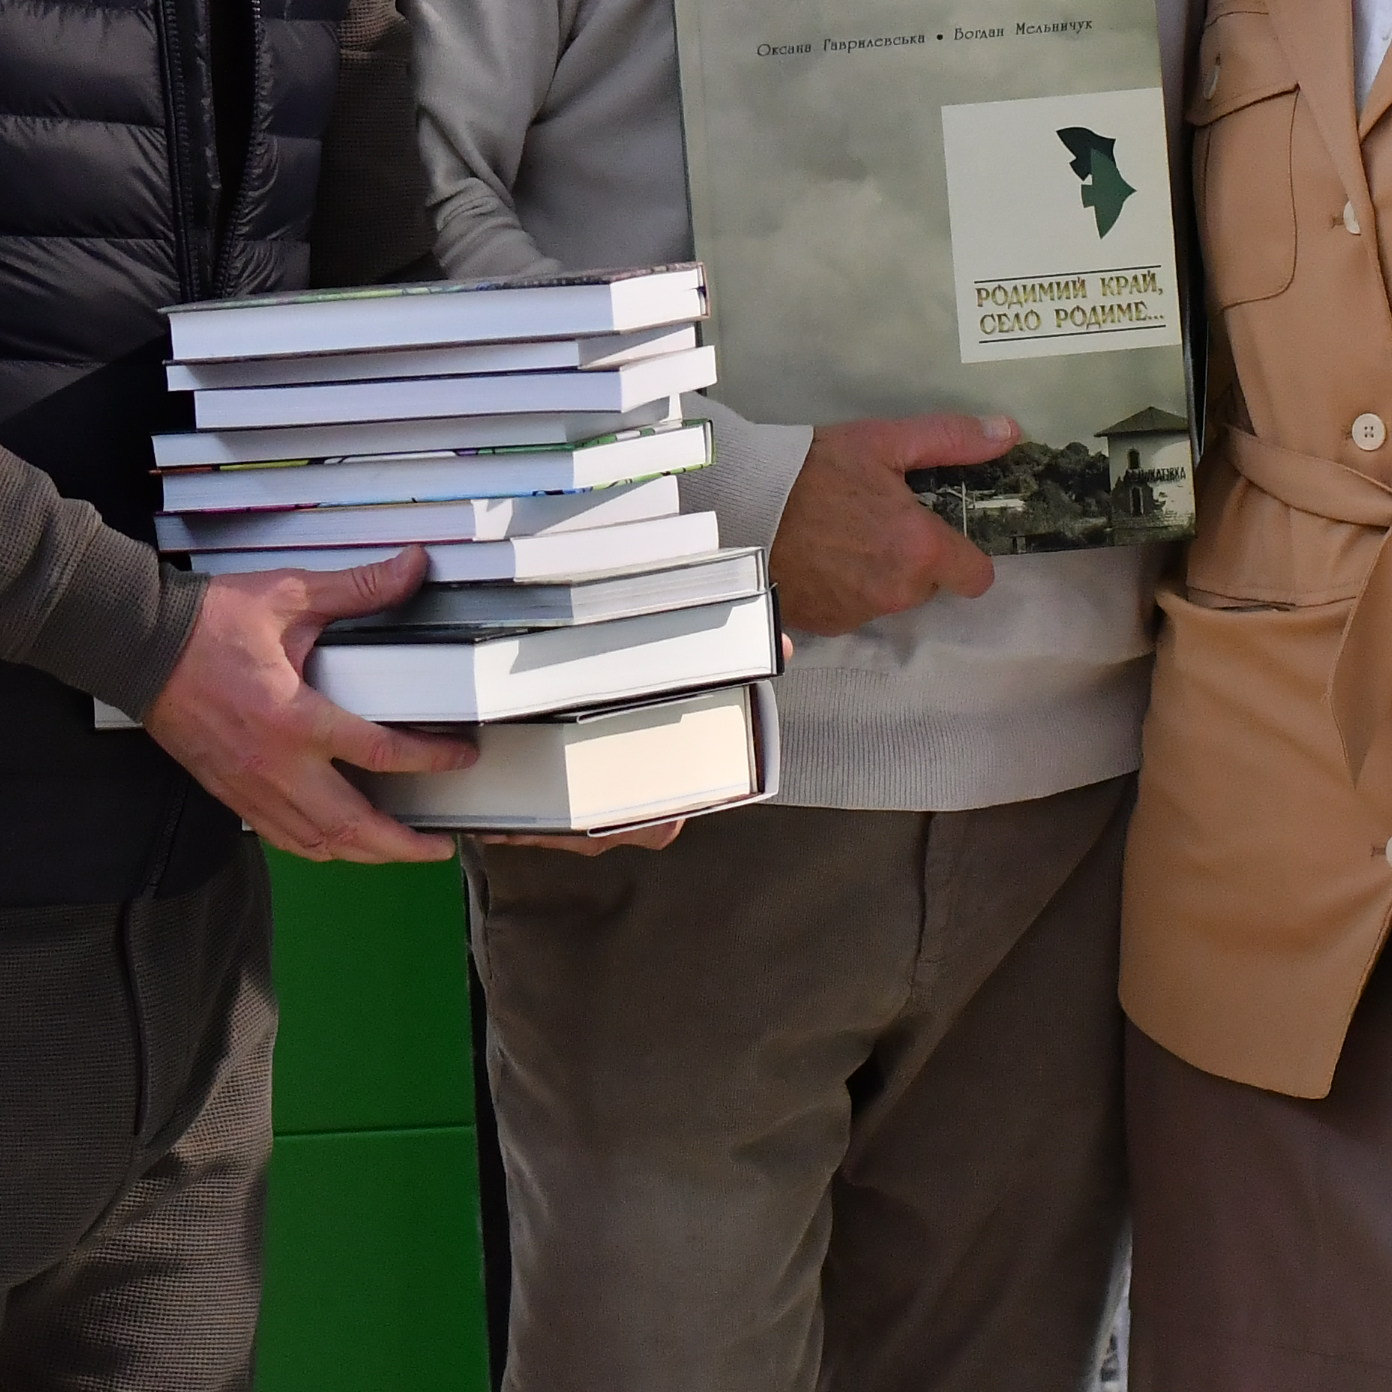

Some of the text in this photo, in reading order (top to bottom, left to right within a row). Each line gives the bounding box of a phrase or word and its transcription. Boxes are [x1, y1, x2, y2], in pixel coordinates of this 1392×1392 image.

[757, 42, 812, 57] Оксана
[954, 27, 1005, 41] Богдан
[1015, 20, 1093, 36] Мельничук
[975, 270, 1164, 309] РОДИМИЙ КРАЙ,
[979, 309, 1041, 335] СЕЛО
